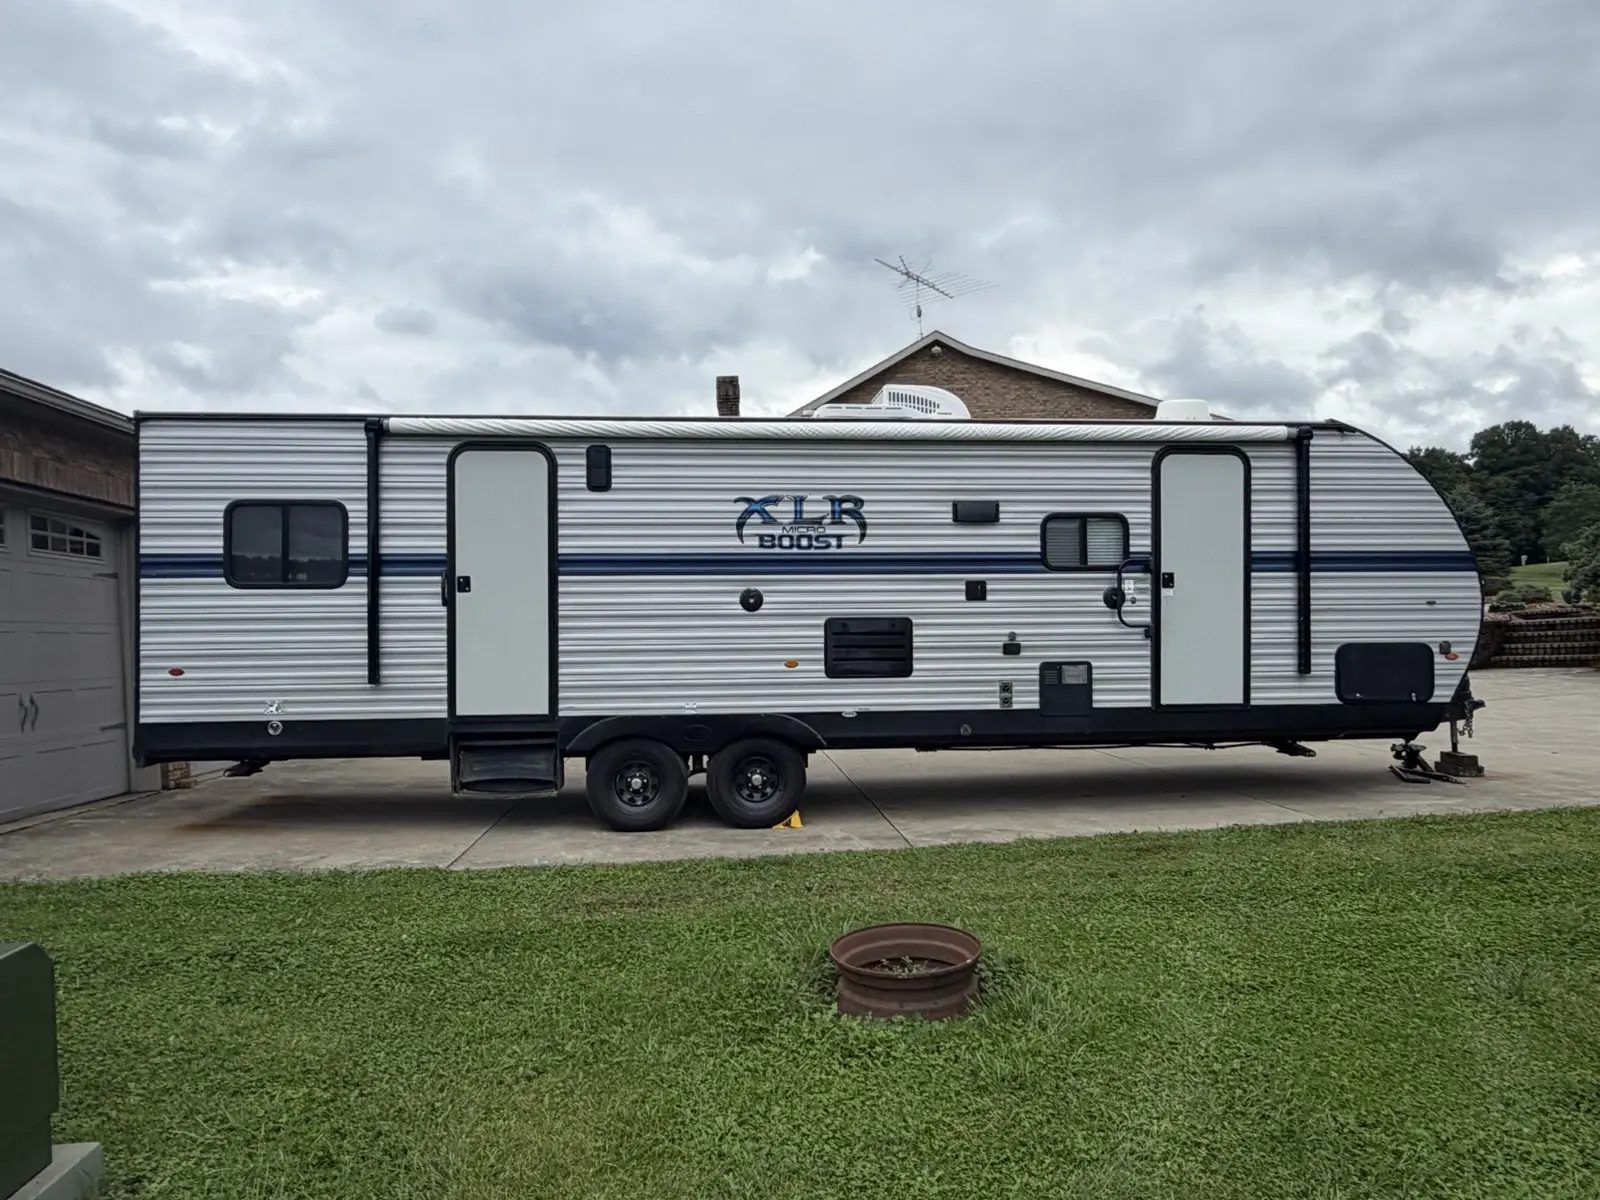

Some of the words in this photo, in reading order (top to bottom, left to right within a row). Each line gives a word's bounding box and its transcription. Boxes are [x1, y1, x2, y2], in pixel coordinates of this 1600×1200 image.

[733, 494, 868, 545] XLR
[781, 526, 826, 534] MICRO
[756, 533, 850, 550] BOOST
